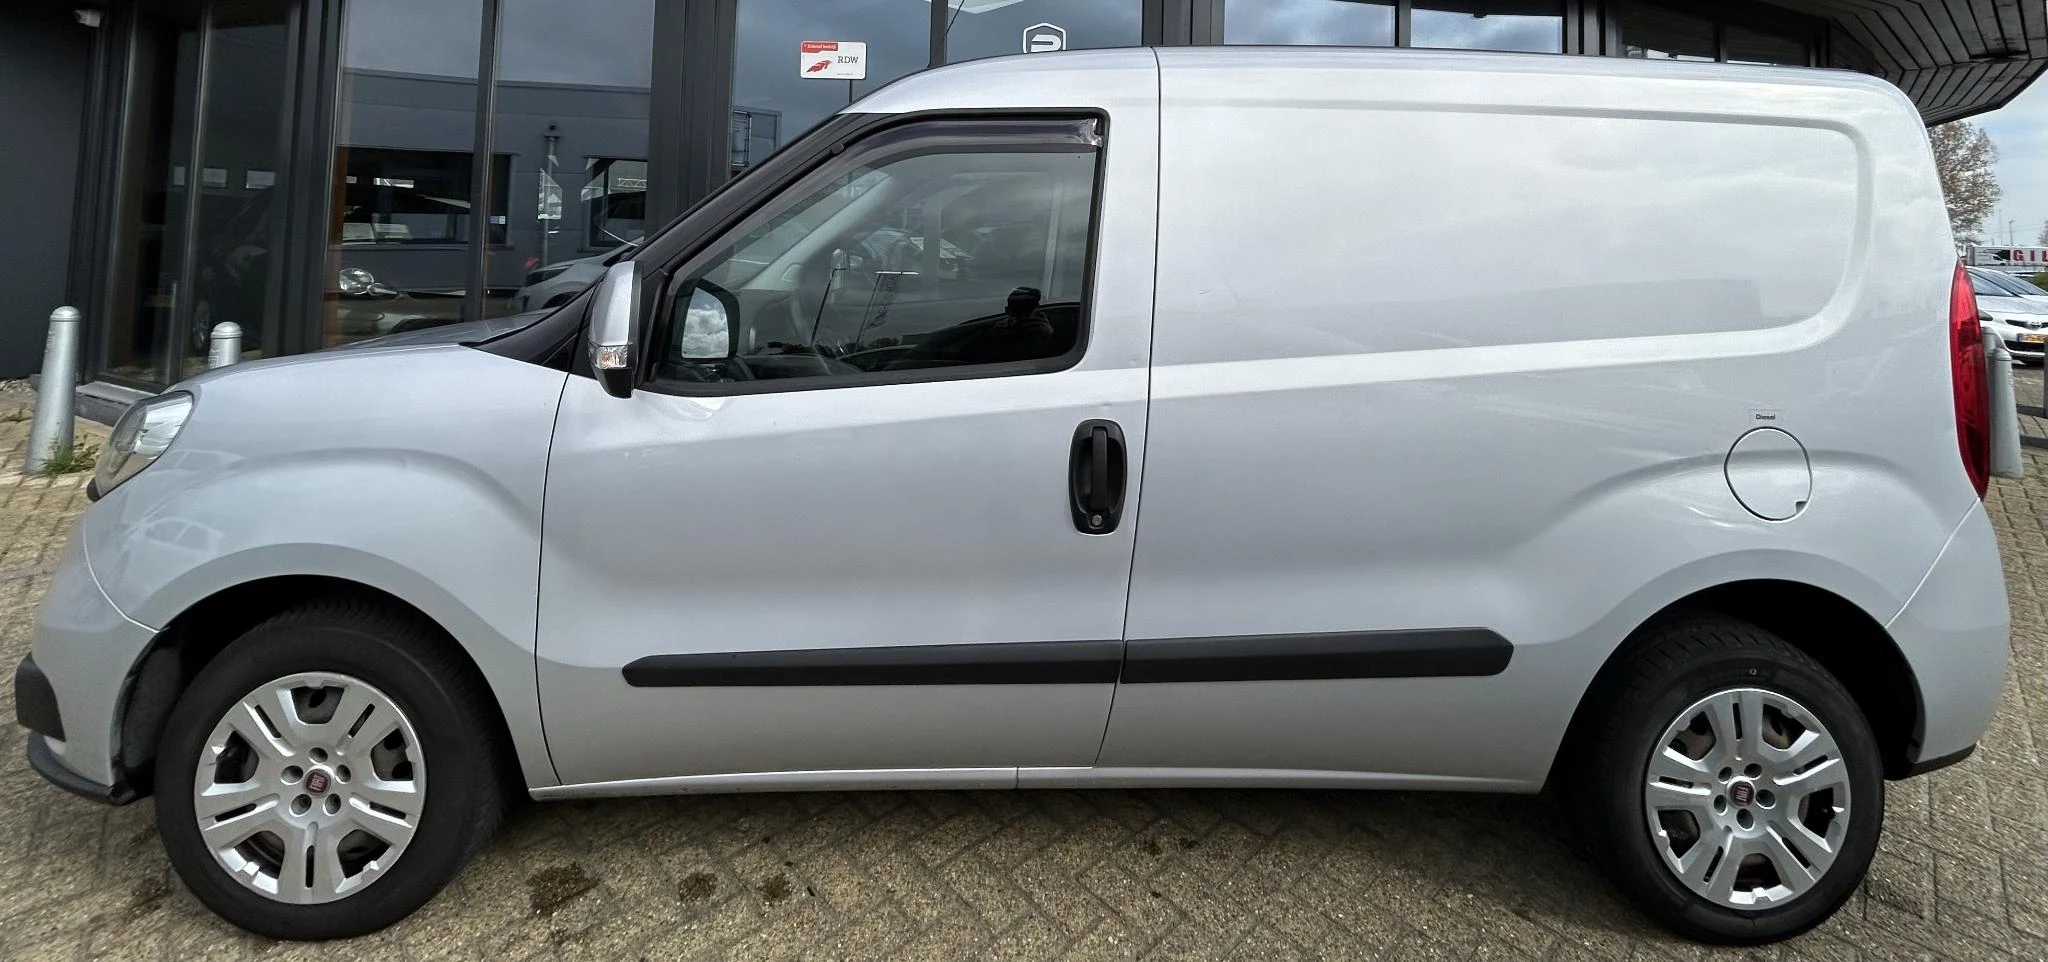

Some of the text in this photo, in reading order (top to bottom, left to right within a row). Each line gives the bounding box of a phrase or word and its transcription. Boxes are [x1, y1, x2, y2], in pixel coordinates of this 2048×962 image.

[837, 56, 859, 64] RDW
[310, 773, 325, 791] FIAT
[1735, 786, 1749, 802] FIAT
